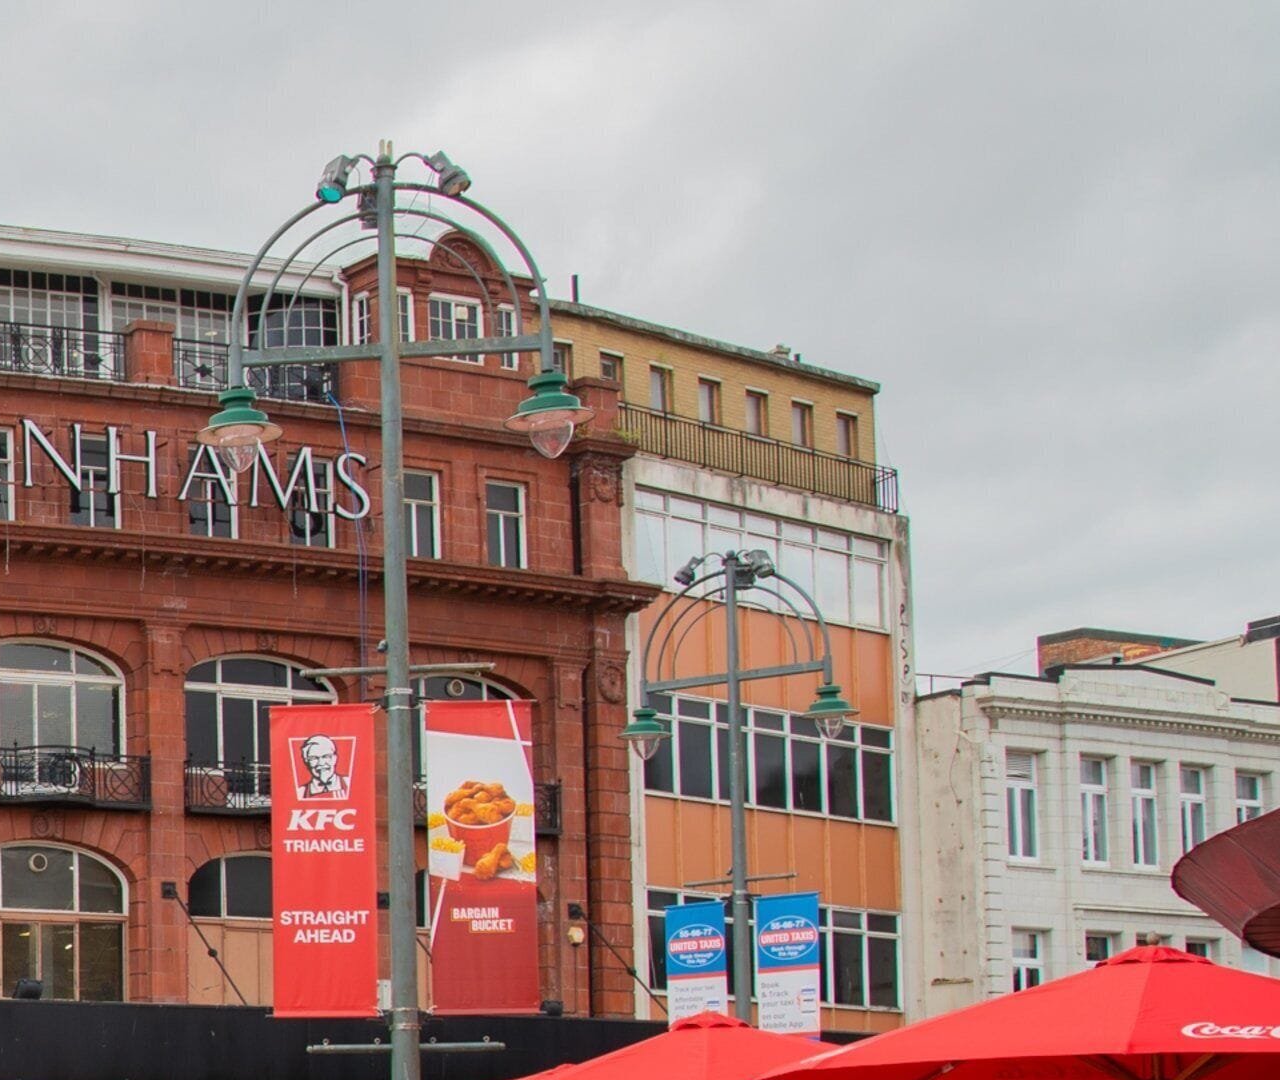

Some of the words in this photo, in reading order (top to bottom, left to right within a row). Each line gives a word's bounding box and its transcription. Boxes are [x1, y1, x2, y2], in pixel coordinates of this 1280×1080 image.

[287, 809, 357, 831] KFC
[283, 839, 364, 853] TRIANGLE
[280, 910, 369, 925] STRAIGHT
[452, 907, 499, 919] BARGAIN
[471, 919, 514, 931] BUCKET
[294, 929, 356, 943] AHEAD
[760, 933, 789, 944] UNITED
[791, 931, 814, 942] TAXIS
[670, 940, 698, 952] UNITED
[699, 938, 721, 950] TAXIS
